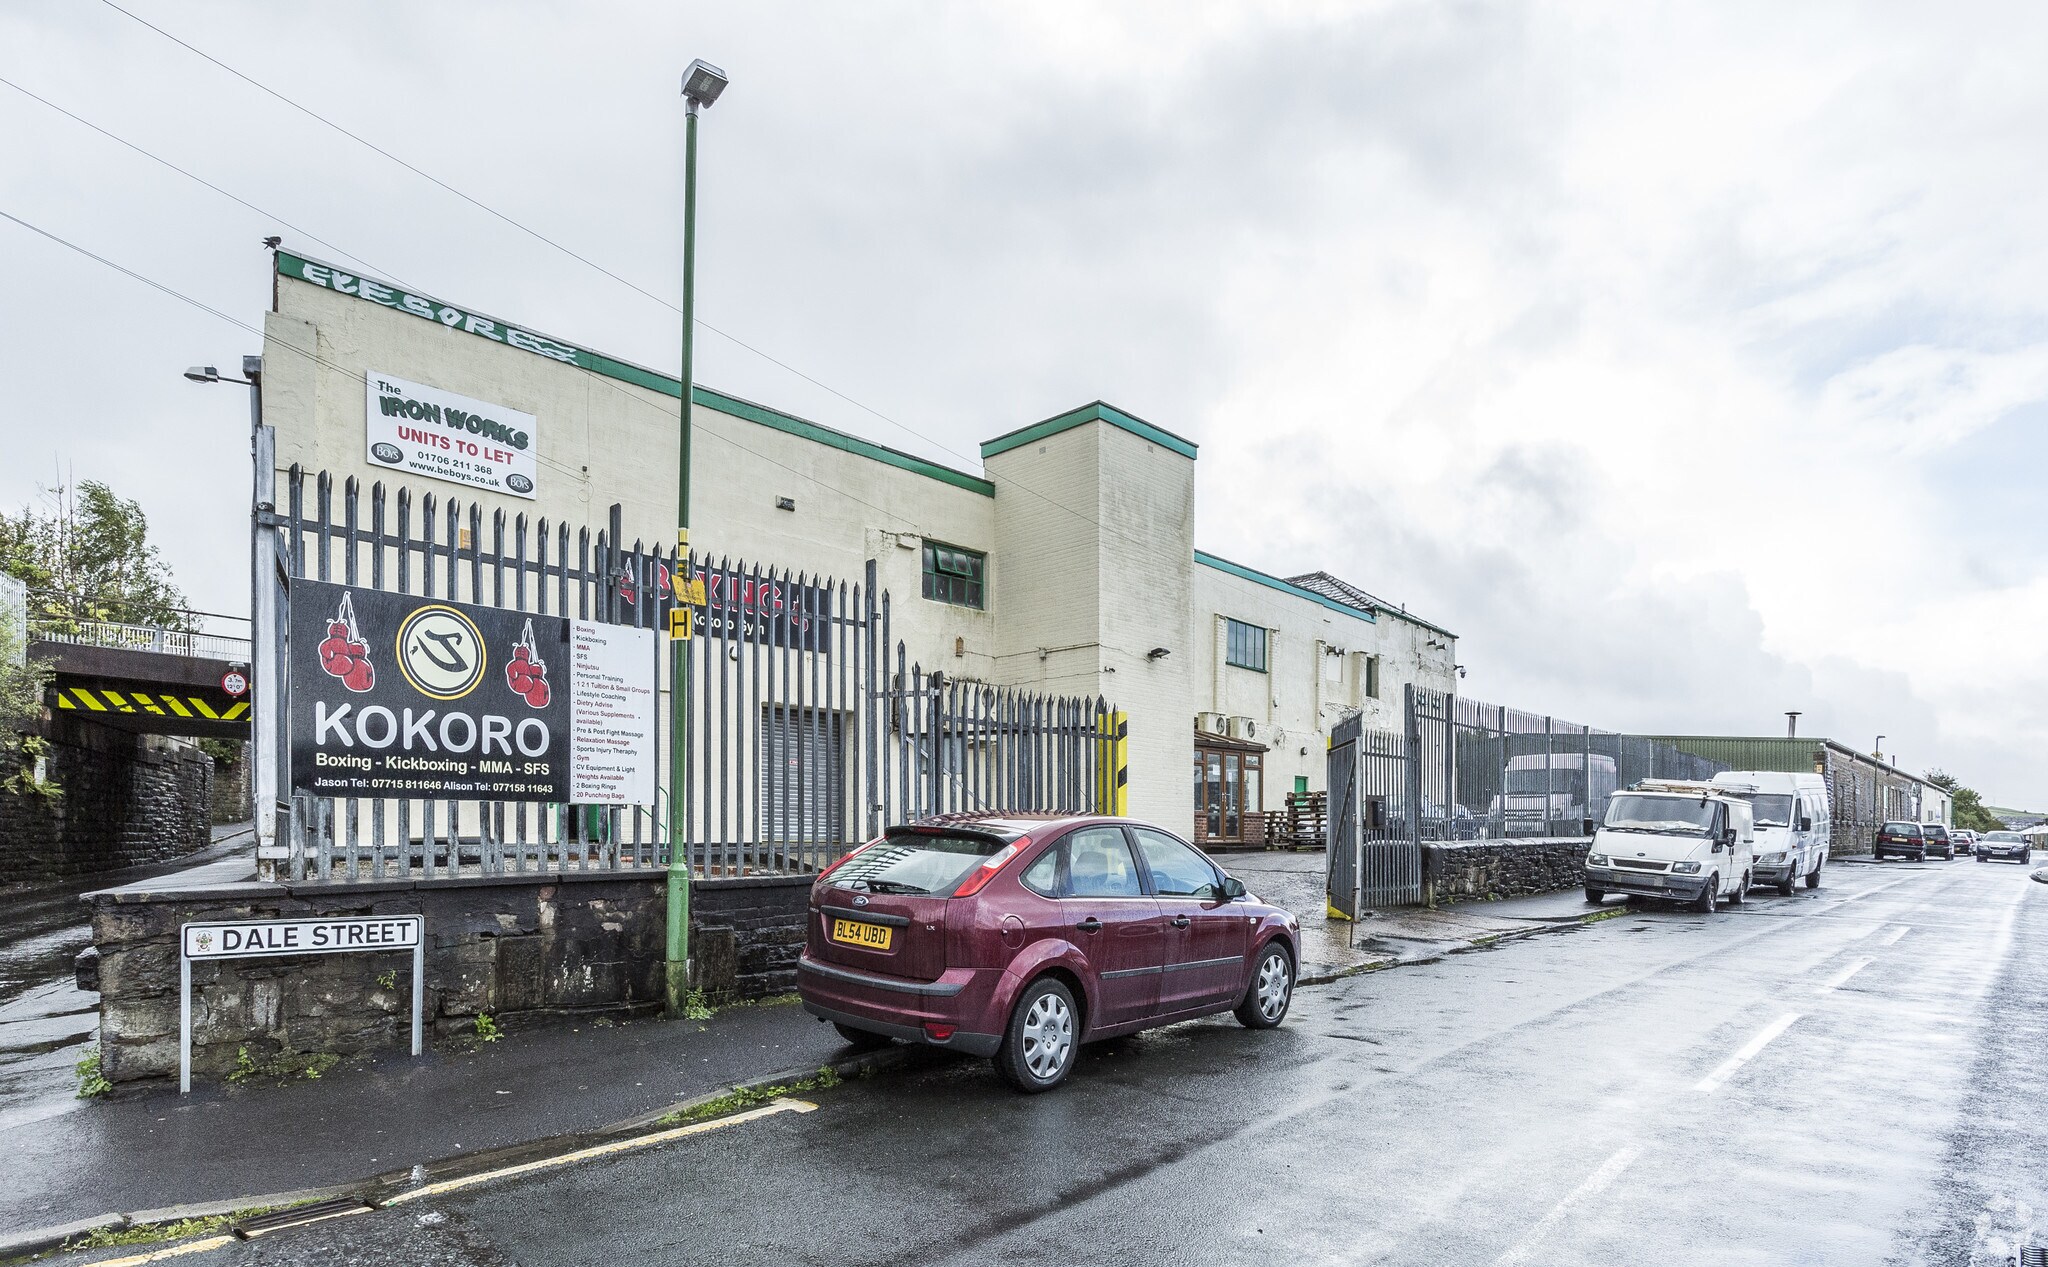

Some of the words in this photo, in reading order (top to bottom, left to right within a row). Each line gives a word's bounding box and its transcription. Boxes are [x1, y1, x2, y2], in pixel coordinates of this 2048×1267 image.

[377, 380, 401, 395] The
[379, 395, 441, 424] IRON
[444, 407, 529, 450] WORKS
[397, 425, 451, 450] UNITS
[456, 439, 478, 457] TO
[484, 447, 514, 465] LET
[417, 451, 450, 465] 01706
[452, 459, 470, 470] 211
[474, 464, 493, 475] 368
[409, 460, 500, 487] www.beboys.co.uk
[650, 562, 783, 618] BXNG
[672, 611, 688, 637] H
[692, 611, 735, 630] Kooo
[576, 625, 596, 635] Boxing
[576, 635, 607, 645] Kickboxing
[576, 662, 600, 671] Ninjutsu
[576, 672, 601, 680] Personal
[601, 674, 624, 683] Training
[591, 682, 609, 690] Tuition
[631, 686, 651, 694] Groups
[576, 690, 600, 698] Lifestyle
[601, 692, 627, 701] Coaching
[576, 699, 594, 707] Dietry
[594, 700, 613, 708] Advise
[576, 709, 600, 717] (Various
[600, 710, 635, 719] Supplements
[576, 718, 603, 726] available)
[315, 701, 550, 757] KOKORO
[606, 729, 620, 737] Fight
[620, 730, 644, 739] Massage
[576, 736, 606, 744] Relaxation
[606, 738, 630, 746] Massage
[576, 745, 595, 754] Sports
[595, 747, 612, 755] Injury
[576, 754, 590, 762] Gym
[315, 752, 372, 771] Boxing
[385, 755, 467, 775] Kickboxing
[479, 760, 513, 774] MMA
[524, 762, 550, 776] SFS
[586, 764, 616, 773] Equipment
[576, 773, 599, 782] Weights
[314, 777, 348, 787] Jason
[350, 778, 369, 788] Tel:
[371, 779, 403, 789] 07715
[405, 780, 442, 790] 811646
[443, 781, 473, 791] Alison
[475, 782, 491, 791] Tel:
[492, 783, 526, 792] 077158
[527, 784, 553, 793] 11643
[581, 782, 600, 790] Boxing
[601, 783, 617, 791] Rings
[584, 792, 611, 800] Punching
[222, 926, 299, 951] DALE
[311, 922, 411, 946] STREET
[836, 921, 861, 940] BL54
[863, 926, 887, 945] UBD
